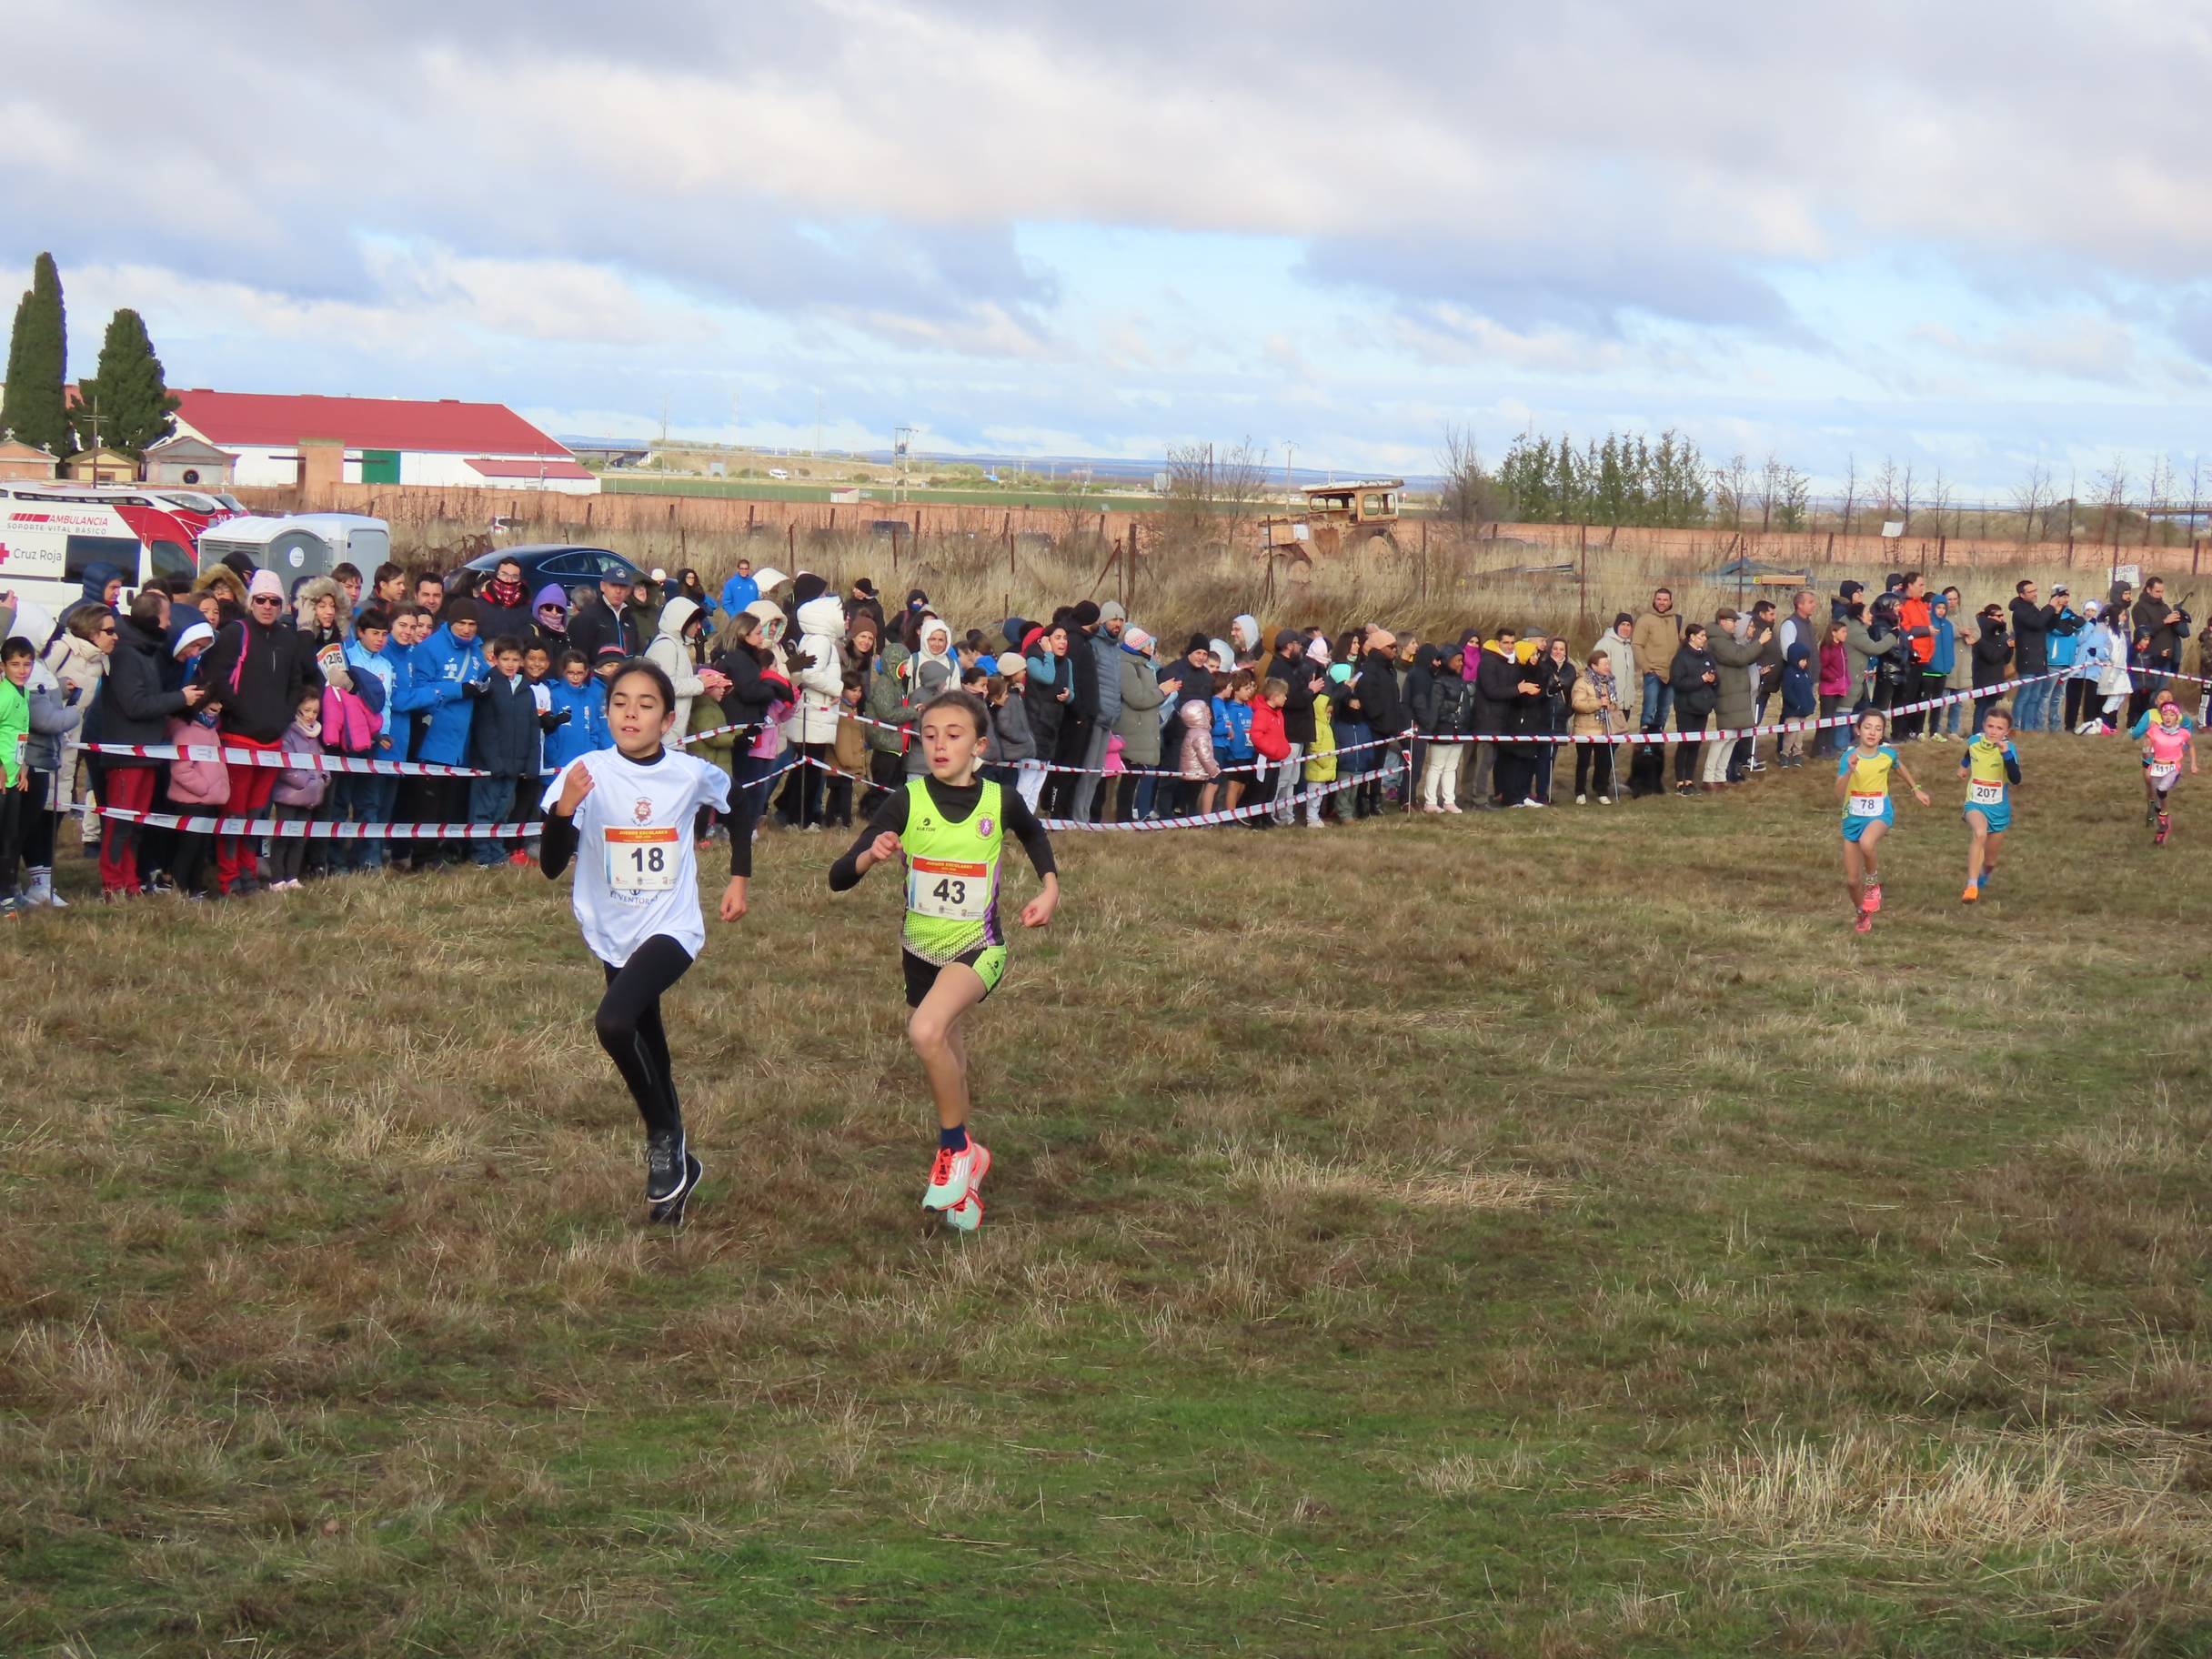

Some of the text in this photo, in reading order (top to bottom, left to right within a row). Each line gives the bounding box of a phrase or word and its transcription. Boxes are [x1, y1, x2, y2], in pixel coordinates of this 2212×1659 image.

[49, 515, 108, 526] AMBULANCIA
[7, 522, 45, 531] SOPORTE
[48, 525, 71, 533] VITAL
[14, 548, 62, 563] Cruz Roja
[1977, 787, 1997, 798] 207
[1860, 799, 1875, 809] 78
[631, 847, 665, 872] 18
[933, 879, 966, 904] 43
